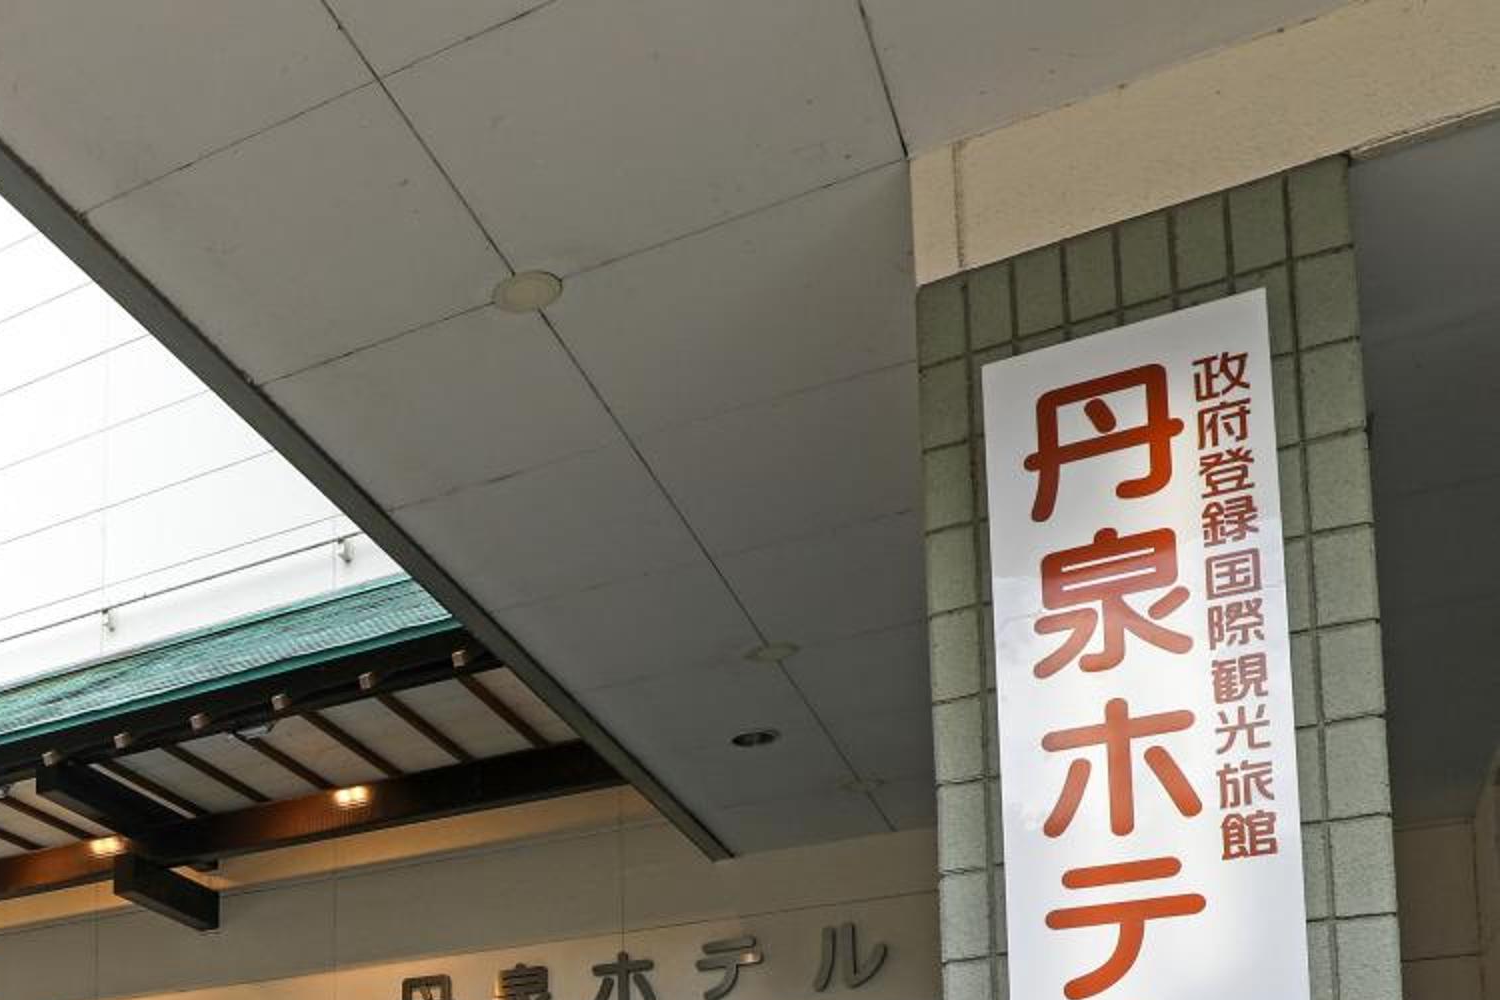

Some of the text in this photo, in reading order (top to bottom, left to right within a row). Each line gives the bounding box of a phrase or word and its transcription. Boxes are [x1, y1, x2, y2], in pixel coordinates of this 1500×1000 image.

[1191, 350, 1279, 861] 政府登録国際観光旅館
